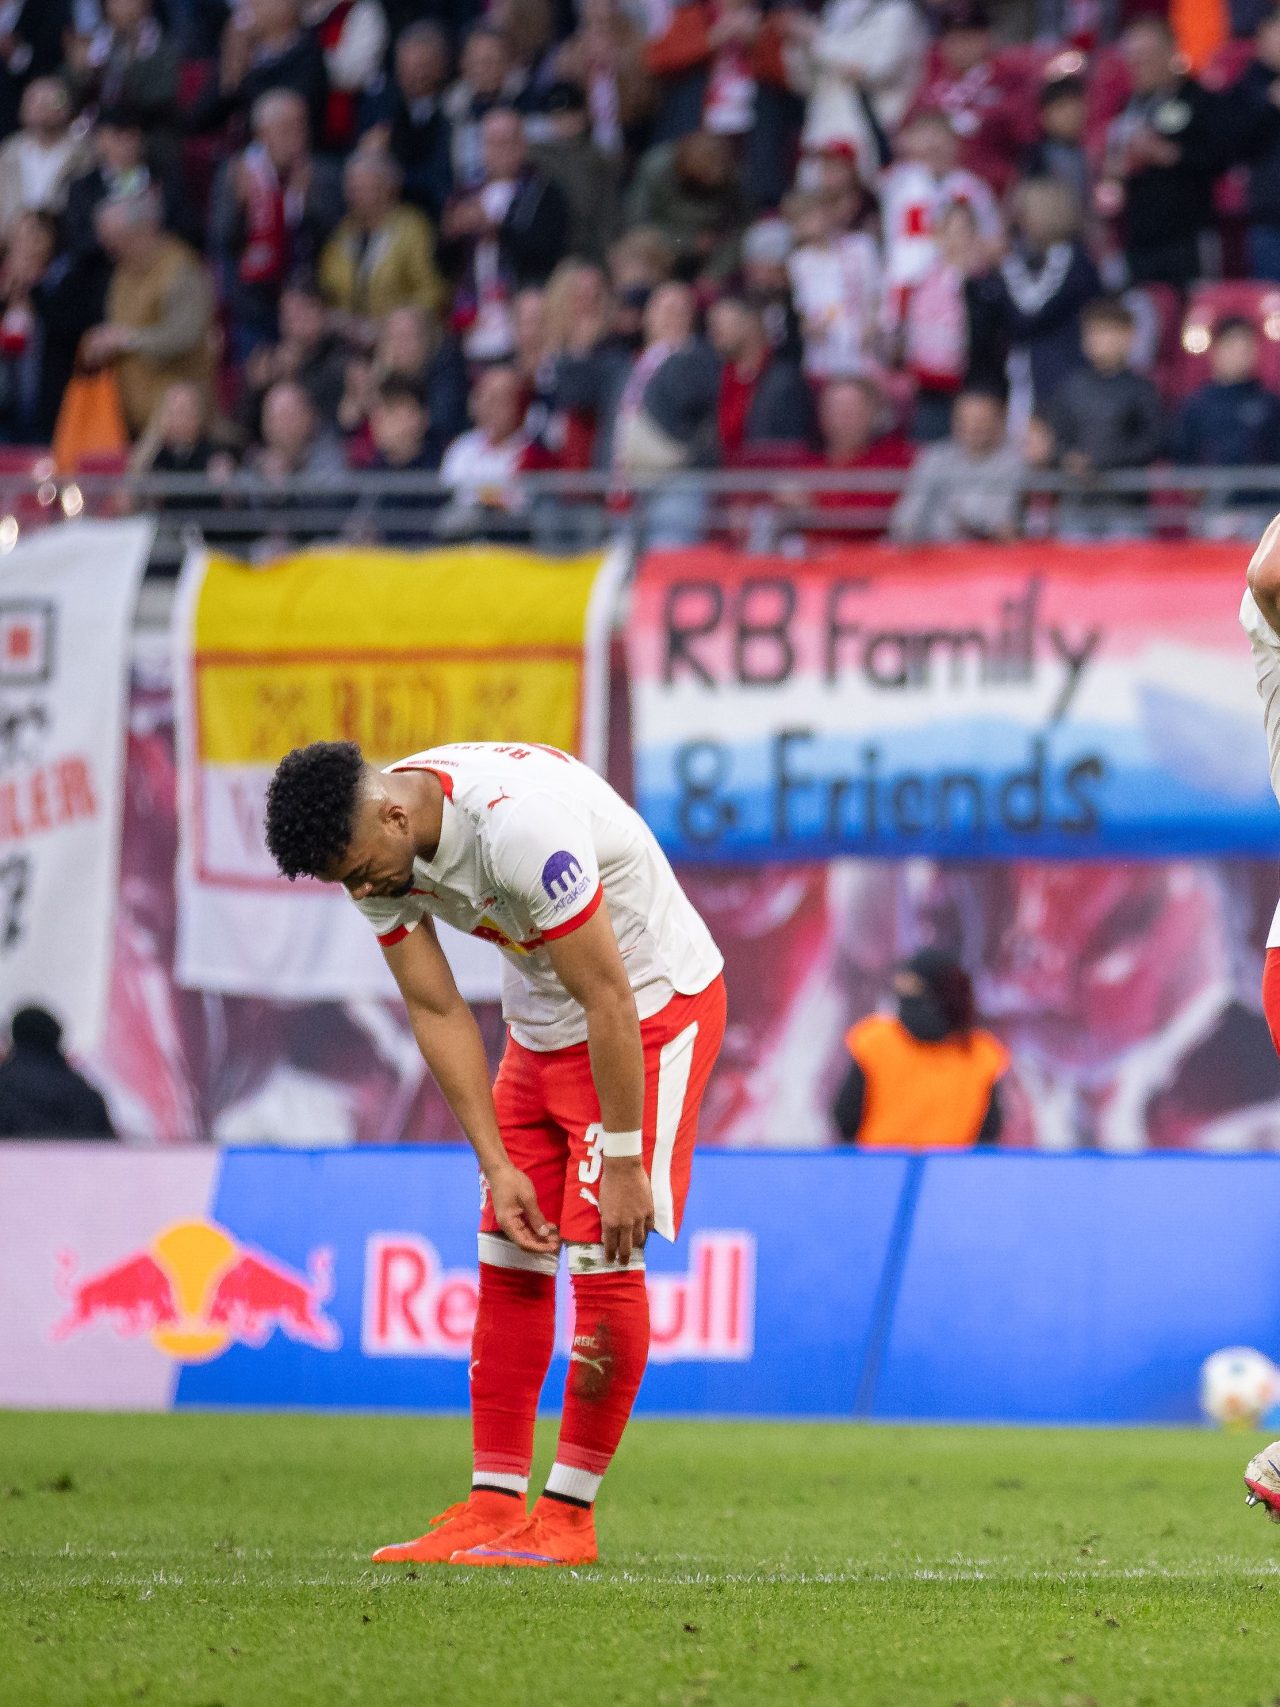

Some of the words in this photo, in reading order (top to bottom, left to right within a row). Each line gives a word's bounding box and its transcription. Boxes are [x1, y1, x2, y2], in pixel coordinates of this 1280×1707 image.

[658, 576, 799, 692] RB
[824, 566, 1102, 730] Family
[672, 738, 740, 846] &
[772, 722, 1116, 848] Friends
[553, 876, 591, 913] kraken
[375, 1242, 479, 1347] Re
